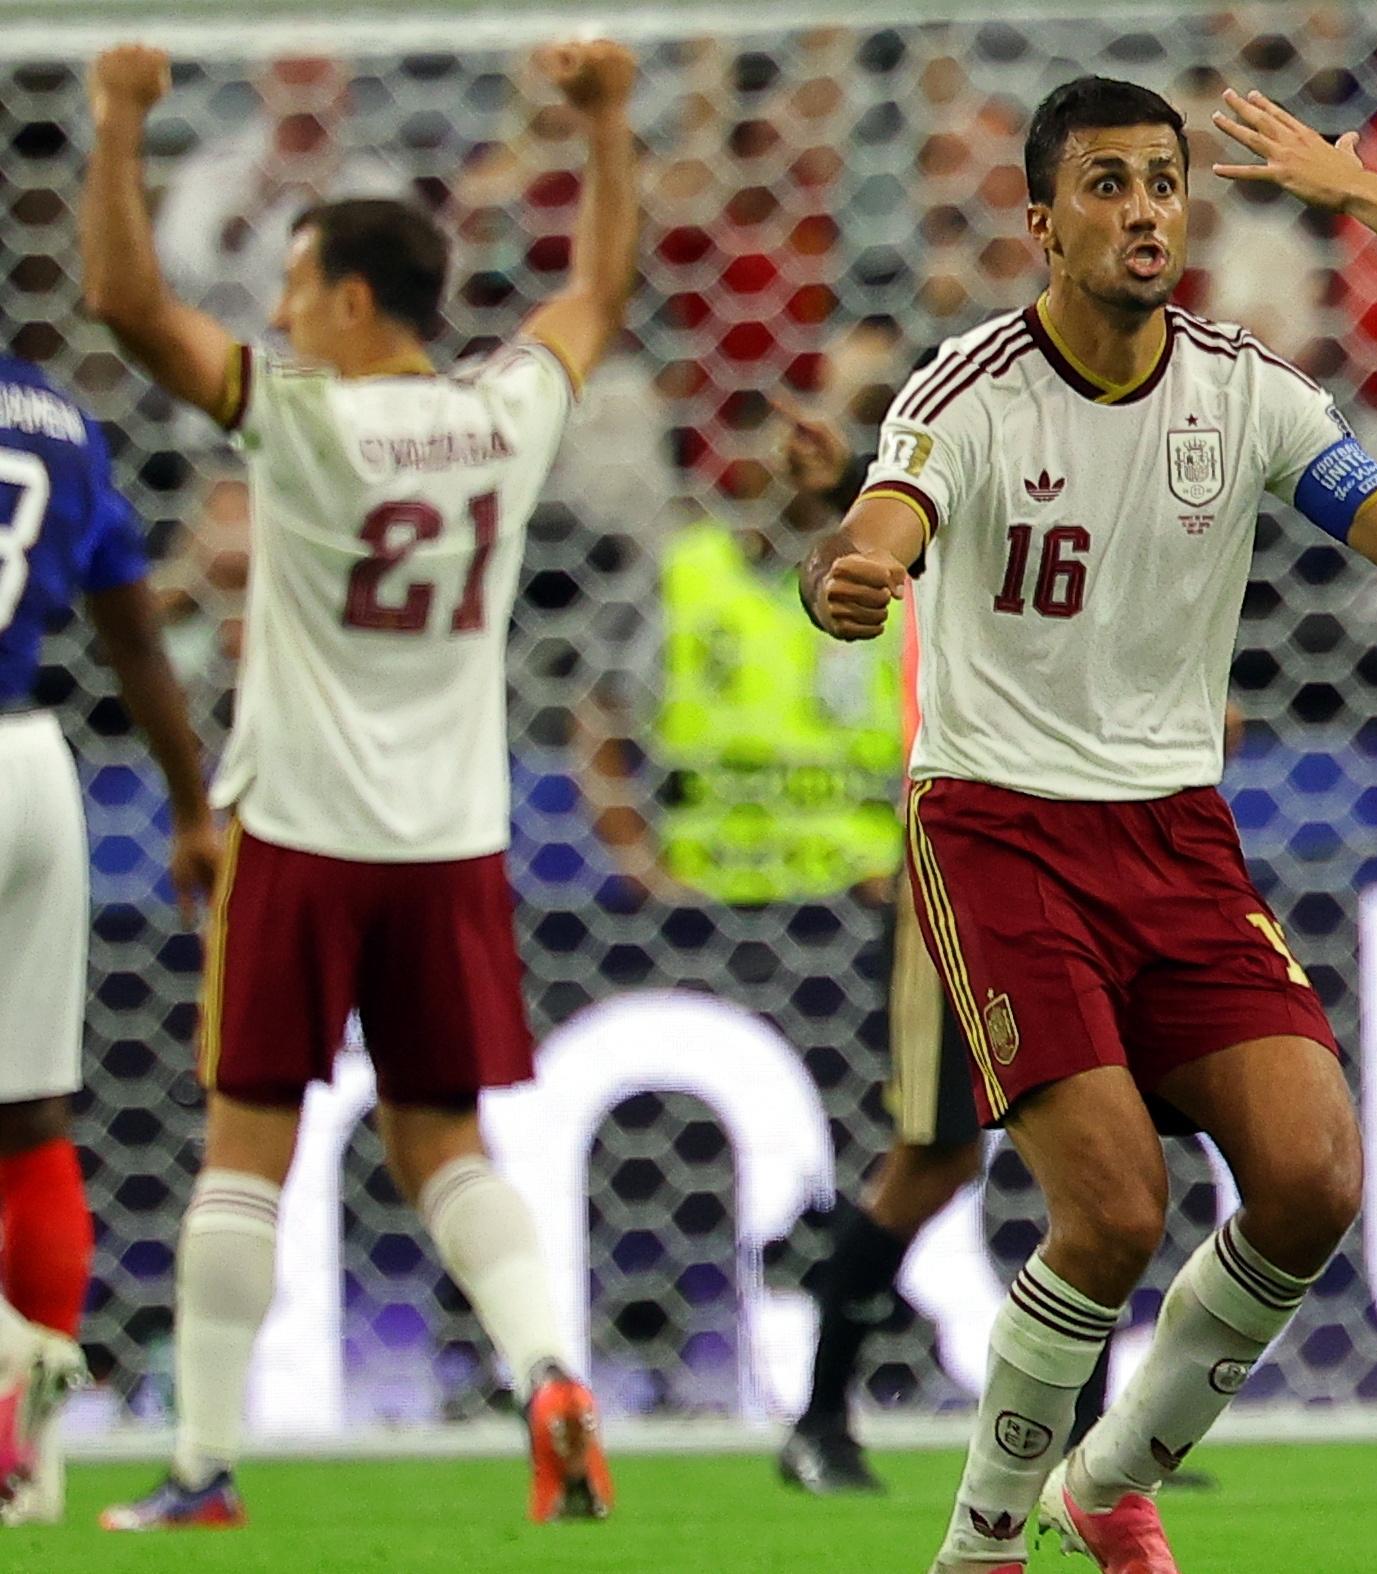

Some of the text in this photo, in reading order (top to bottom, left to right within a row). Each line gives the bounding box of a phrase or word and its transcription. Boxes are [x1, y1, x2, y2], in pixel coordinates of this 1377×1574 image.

[343, 491, 500, 636] 21
[993, 523, 1091, 619] 16
[1245, 912, 1311, 988] 1
